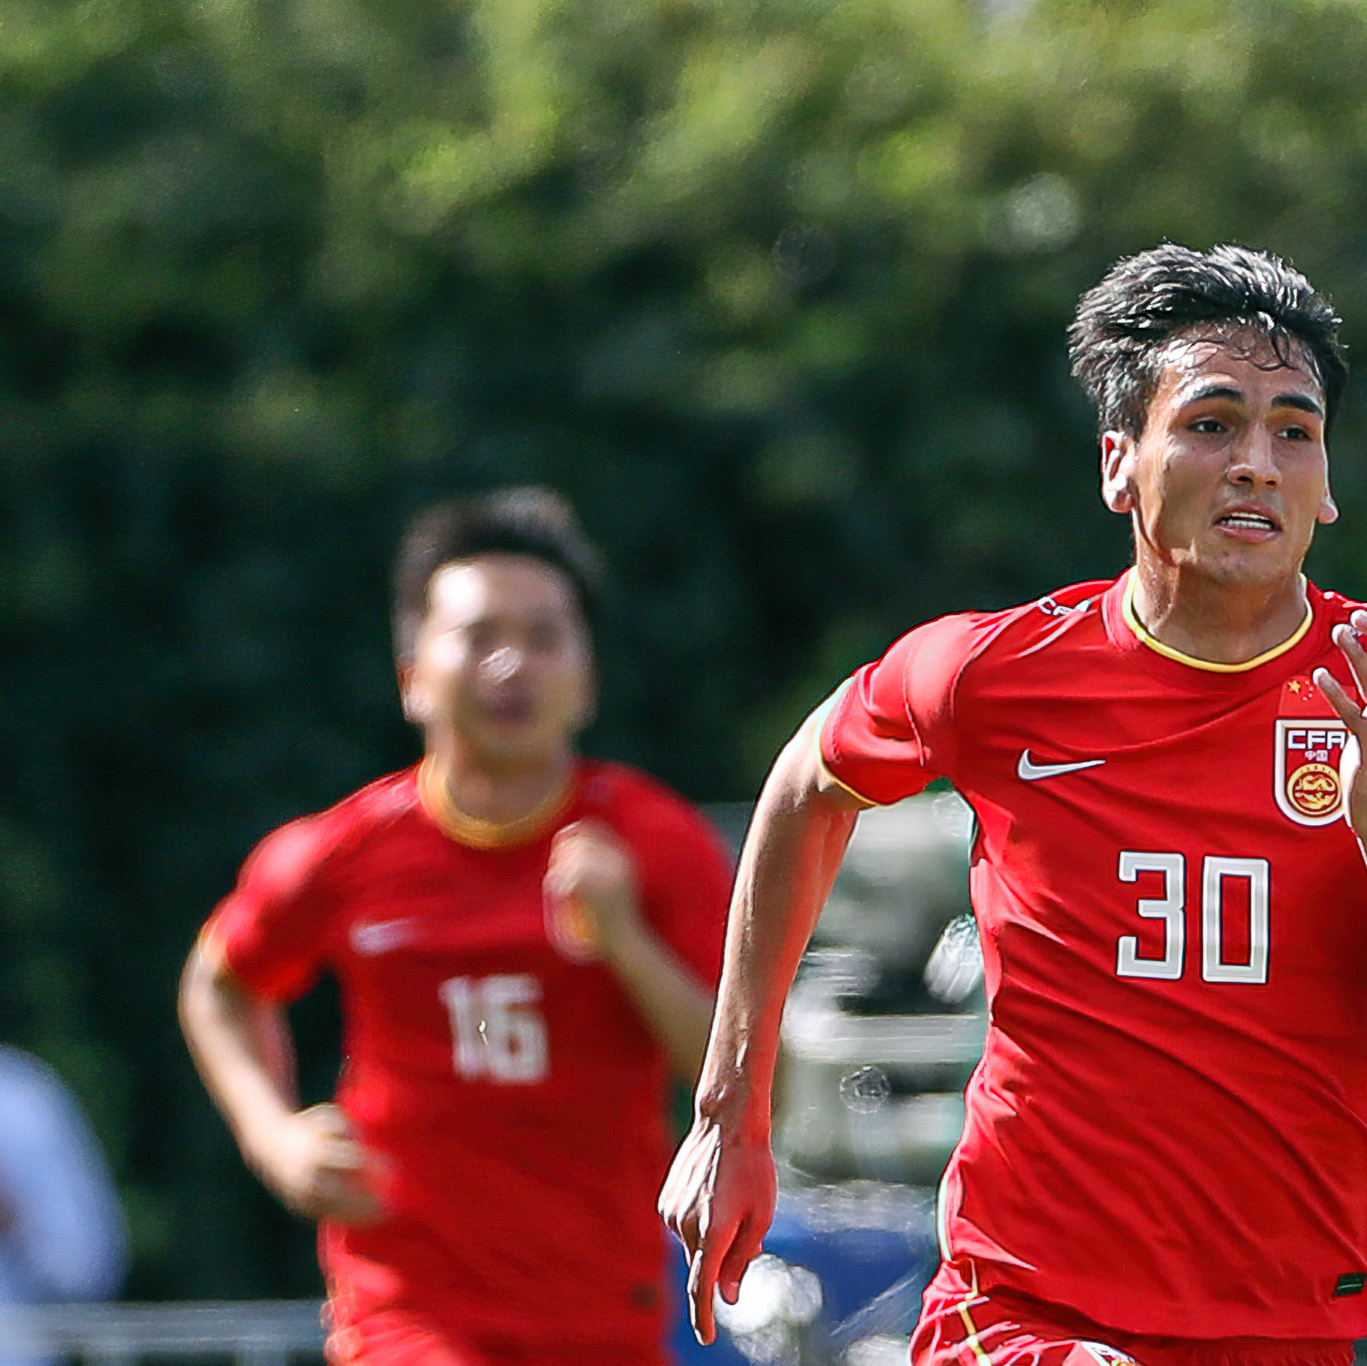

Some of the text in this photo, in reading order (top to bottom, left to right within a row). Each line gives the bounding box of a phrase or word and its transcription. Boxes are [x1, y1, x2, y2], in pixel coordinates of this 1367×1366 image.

[1287, 730, 1346, 750] CFA
[1115, 850, 1271, 985] 30
[437, 972, 552, 1084] 16
